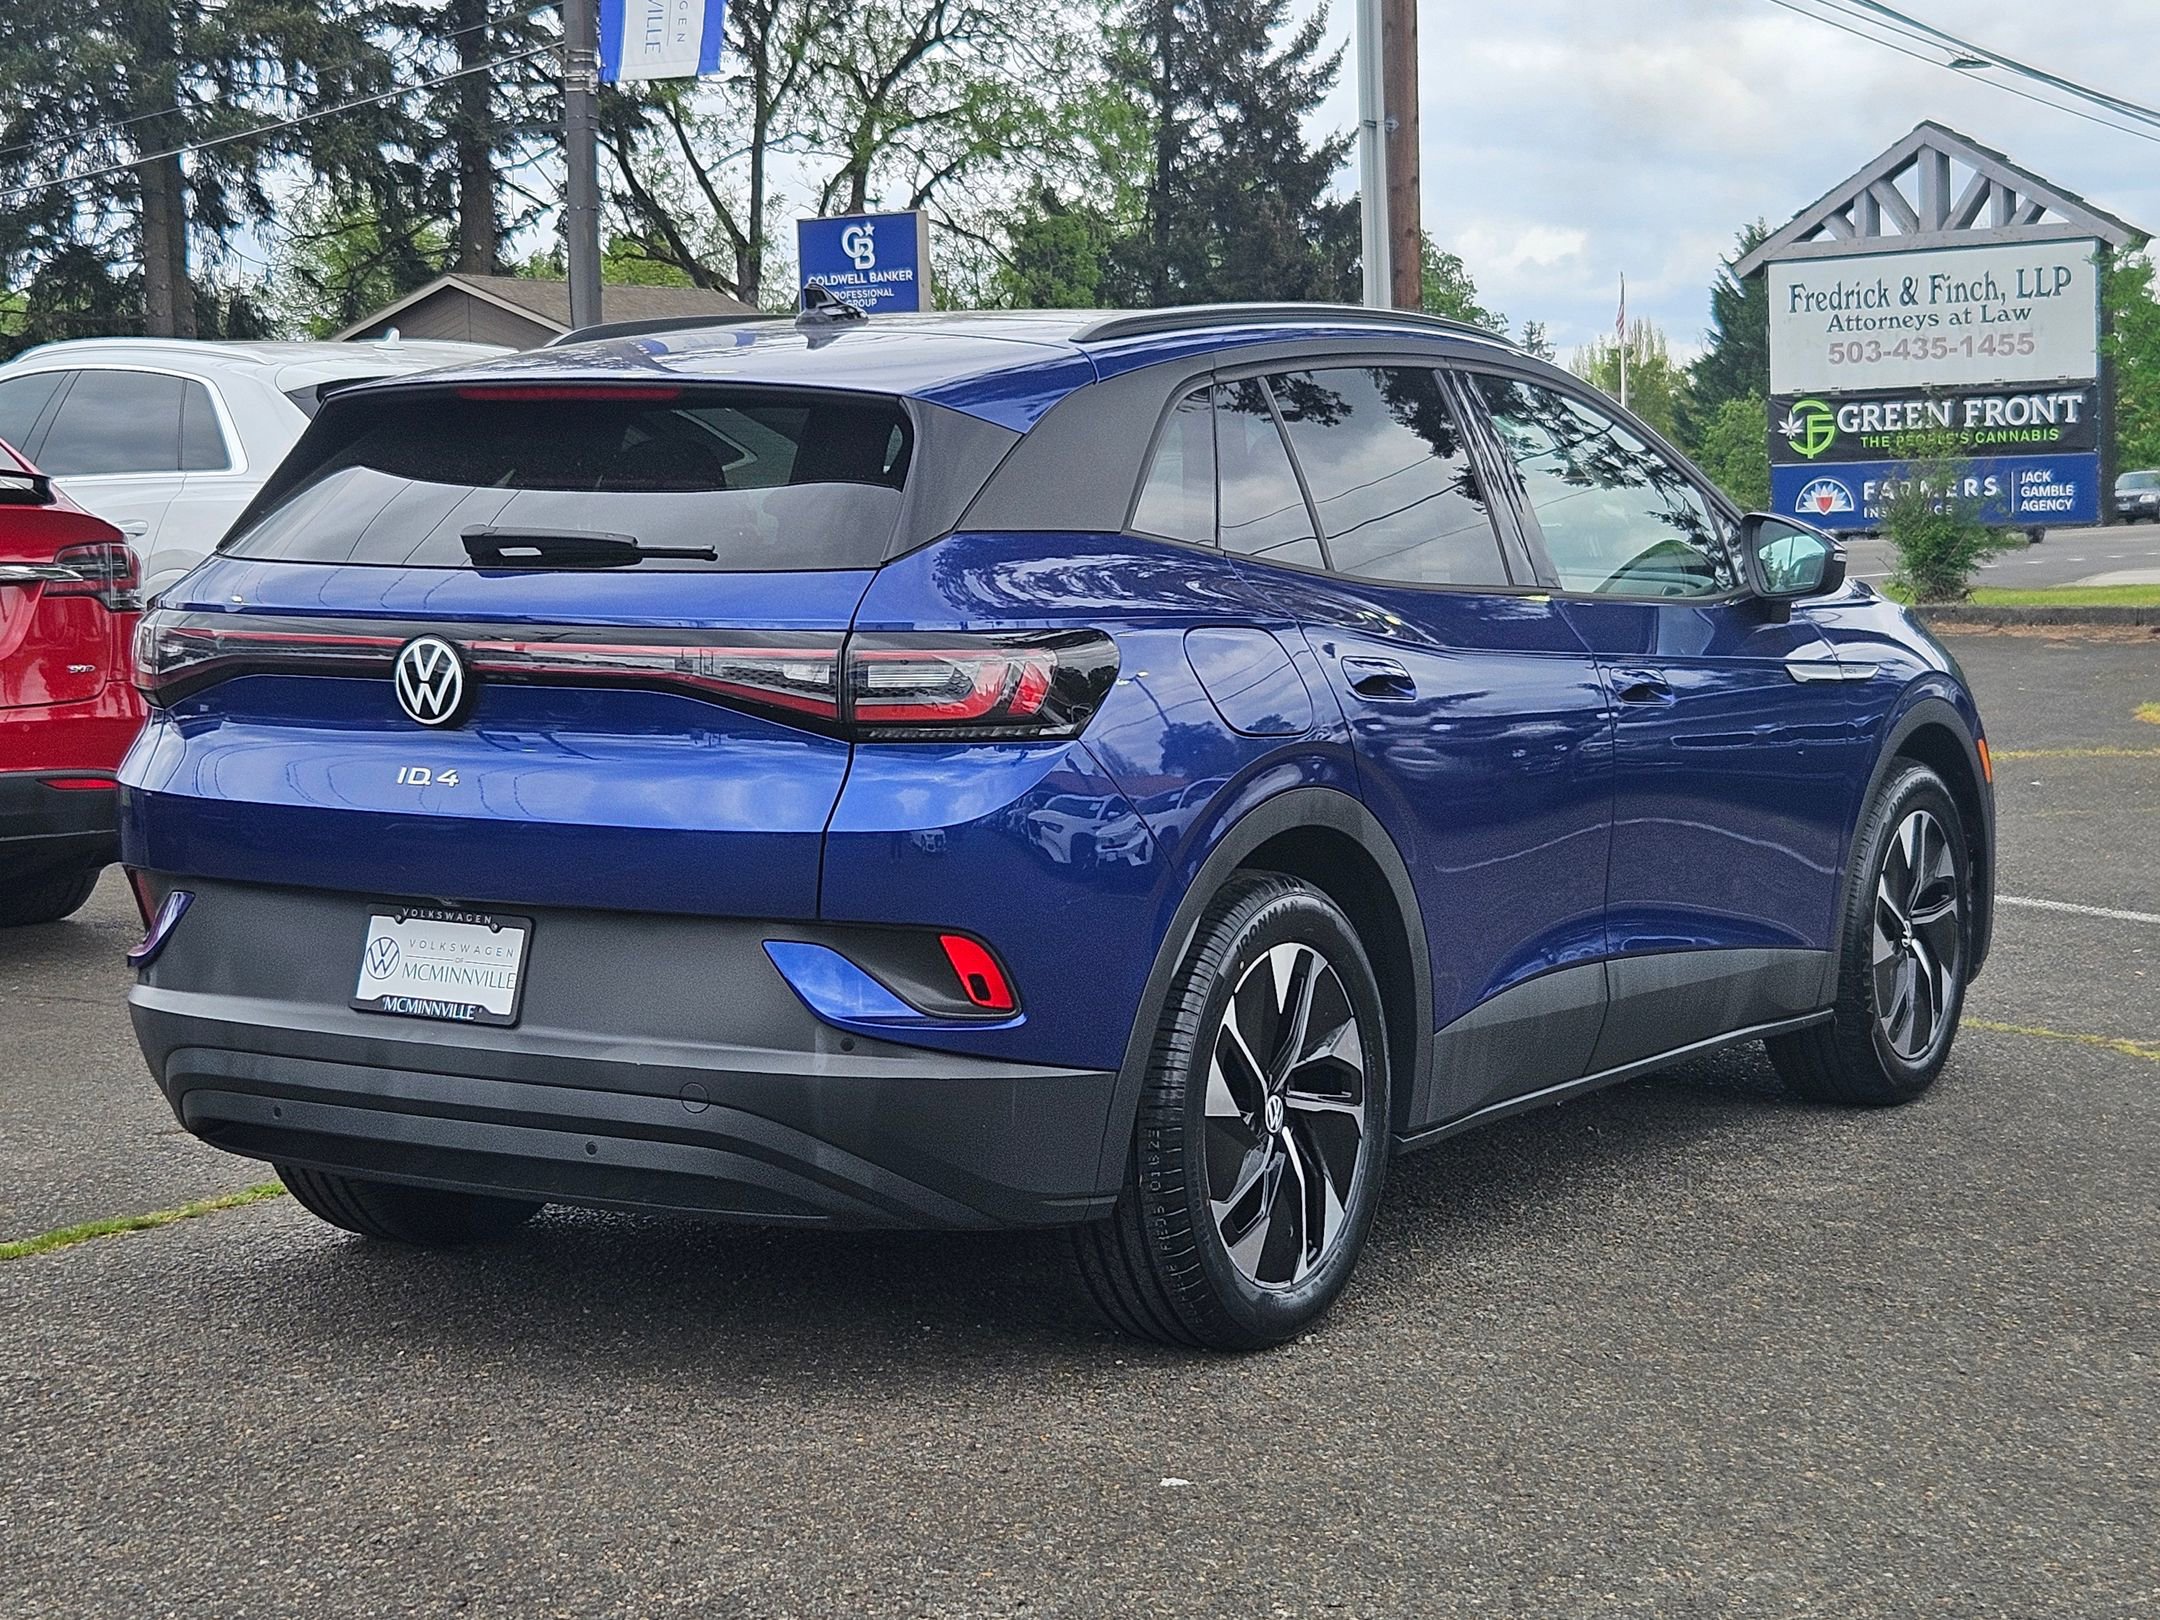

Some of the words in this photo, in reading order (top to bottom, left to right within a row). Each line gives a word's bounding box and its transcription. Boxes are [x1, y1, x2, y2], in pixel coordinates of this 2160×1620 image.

[869, 270, 913, 283] BANKER
[832, 288, 895, 300] ROFESSIONAL
[1788, 278, 1890, 313] Fredrick
[1900, 276, 1919, 306] &
[1929, 270, 2006, 305] Finch,
[2015, 266, 2072, 299] LLP
[1826, 310, 1940, 332] Attorneys
[1949, 309, 1972, 326] at
[1981, 304, 2032, 323] Law
[1828, 332, 2035, 365] 503-435-1455
[1836, 401, 1952, 433] GREEN
[1963, 394, 2082, 428] FRONT
[1860, 434, 1890, 449] THE
[1974, 427, 2061, 444] CANNABIS
[2020, 471, 2051, 484] JACK
[2020, 484, 2074, 498] GAMBLE
[1863, 503, 1953, 518] INSCE
[2020, 498, 2073, 511] AGENCY
[402, 907, 492, 924] VOLKSWAGEN
[409, 938, 515, 958] VOLKSWAGEN
[402, 962, 517, 990] MCMINNVILLE
[383, 996, 475, 1020] MCMINNVILLE
